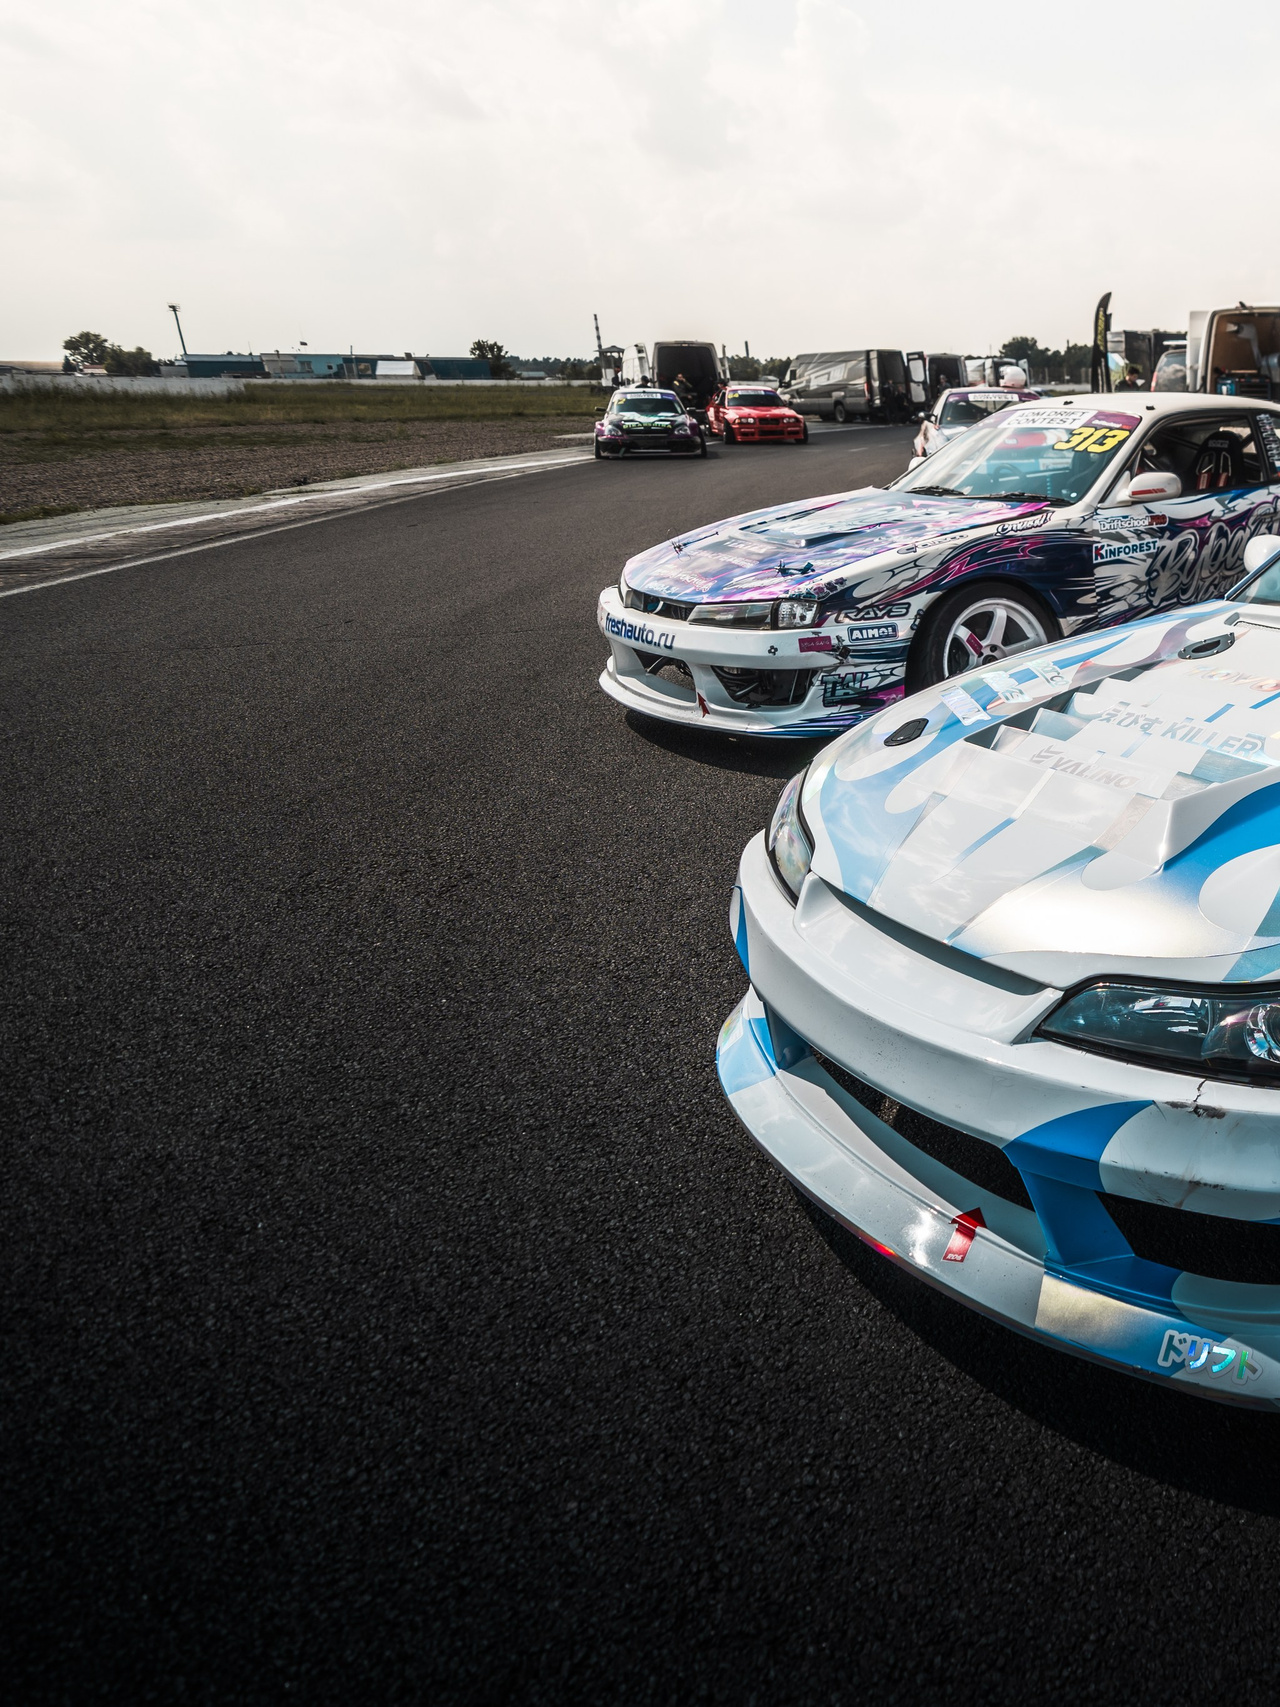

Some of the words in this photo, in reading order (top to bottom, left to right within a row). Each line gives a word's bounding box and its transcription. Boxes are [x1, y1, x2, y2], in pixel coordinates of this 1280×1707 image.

[1007, 418, 1077, 426] CONTEST
[1052, 427, 1130, 454] 313
[1094, 540, 1158, 561] KINFOREST
[836, 603, 911, 622] RAYS
[605, 612, 676, 650] freshauto.ru
[851, 626, 896, 640] AIMOL
[1160, 721, 1262, 758] KILLER
[1055, 755, 1142, 789] VALINO
[1162, 1333, 1259, 1380] ドリフト
